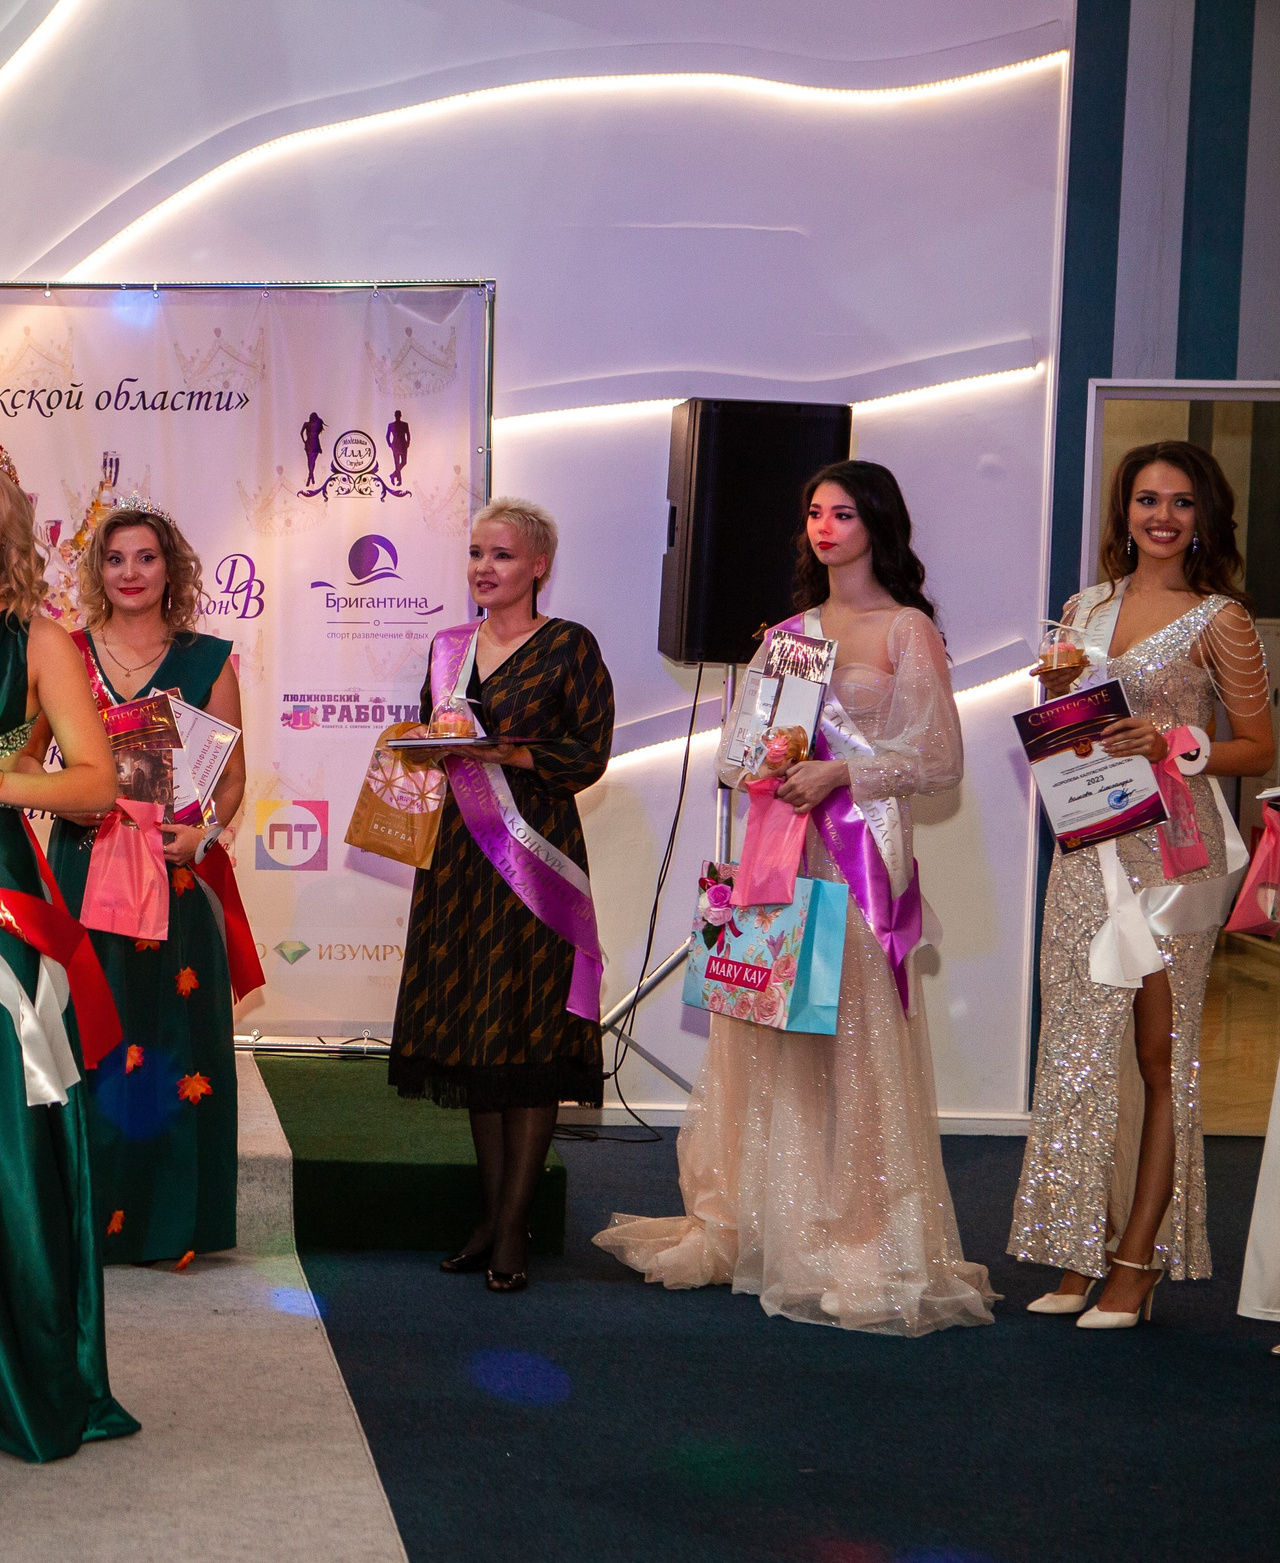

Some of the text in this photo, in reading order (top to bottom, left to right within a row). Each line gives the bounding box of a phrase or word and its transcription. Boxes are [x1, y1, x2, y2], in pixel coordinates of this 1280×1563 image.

[95, 377, 250, 412] области»
[194, 599, 231, 616] лон
[325, 592, 429, 613] Бригантина
[326, 631, 429, 641] спорт развлечение отдых
[282, 692, 360, 703] ЛЮДИНОВСКИЙ
[321, 703, 420, 723] РАБОЧИ
[1028, 689, 1111, 727] CERTIFICATE
[1086, 774, 1105, 786] 2023
[268, 823, 318, 850] ПТ
[317, 943, 405, 962] ИЗУМРУ
[708, 959, 768, 988] MARY KAY
